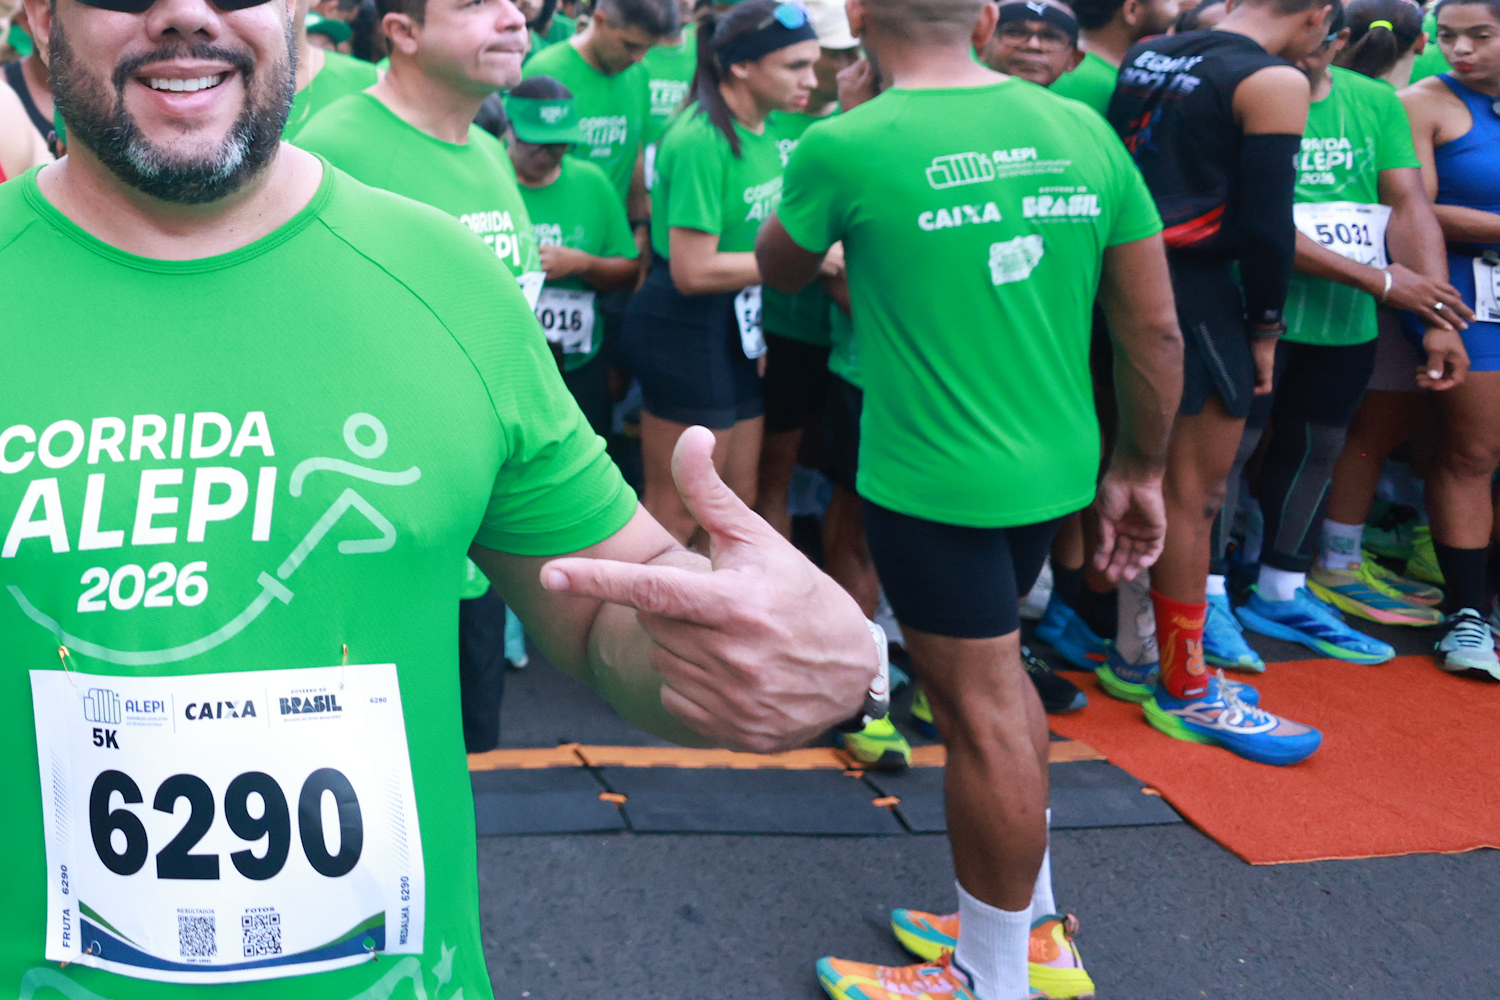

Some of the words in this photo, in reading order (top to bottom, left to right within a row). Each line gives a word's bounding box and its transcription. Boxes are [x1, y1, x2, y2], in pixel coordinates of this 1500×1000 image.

[918, 202, 1002, 231] CAIXA
[1022, 194, 1101, 218] BRASIL
[1316, 224, 1373, 246] 5031
[540, 309, 582, 332] 016
[1, 466, 277, 558] ALEPI
[76, 561, 209, 613] 2026
[125, 700, 165, 713] ALEPI
[185, 700, 257, 721] CAIXA
[279, 694, 343, 716] BRASIL
[92, 727, 120, 750] 5K
[89, 767, 364, 881] 6290
[61, 865, 70, 896] 6290
[400, 876, 410, 902] 6290
[62, 909, 71, 948] FRUTA
